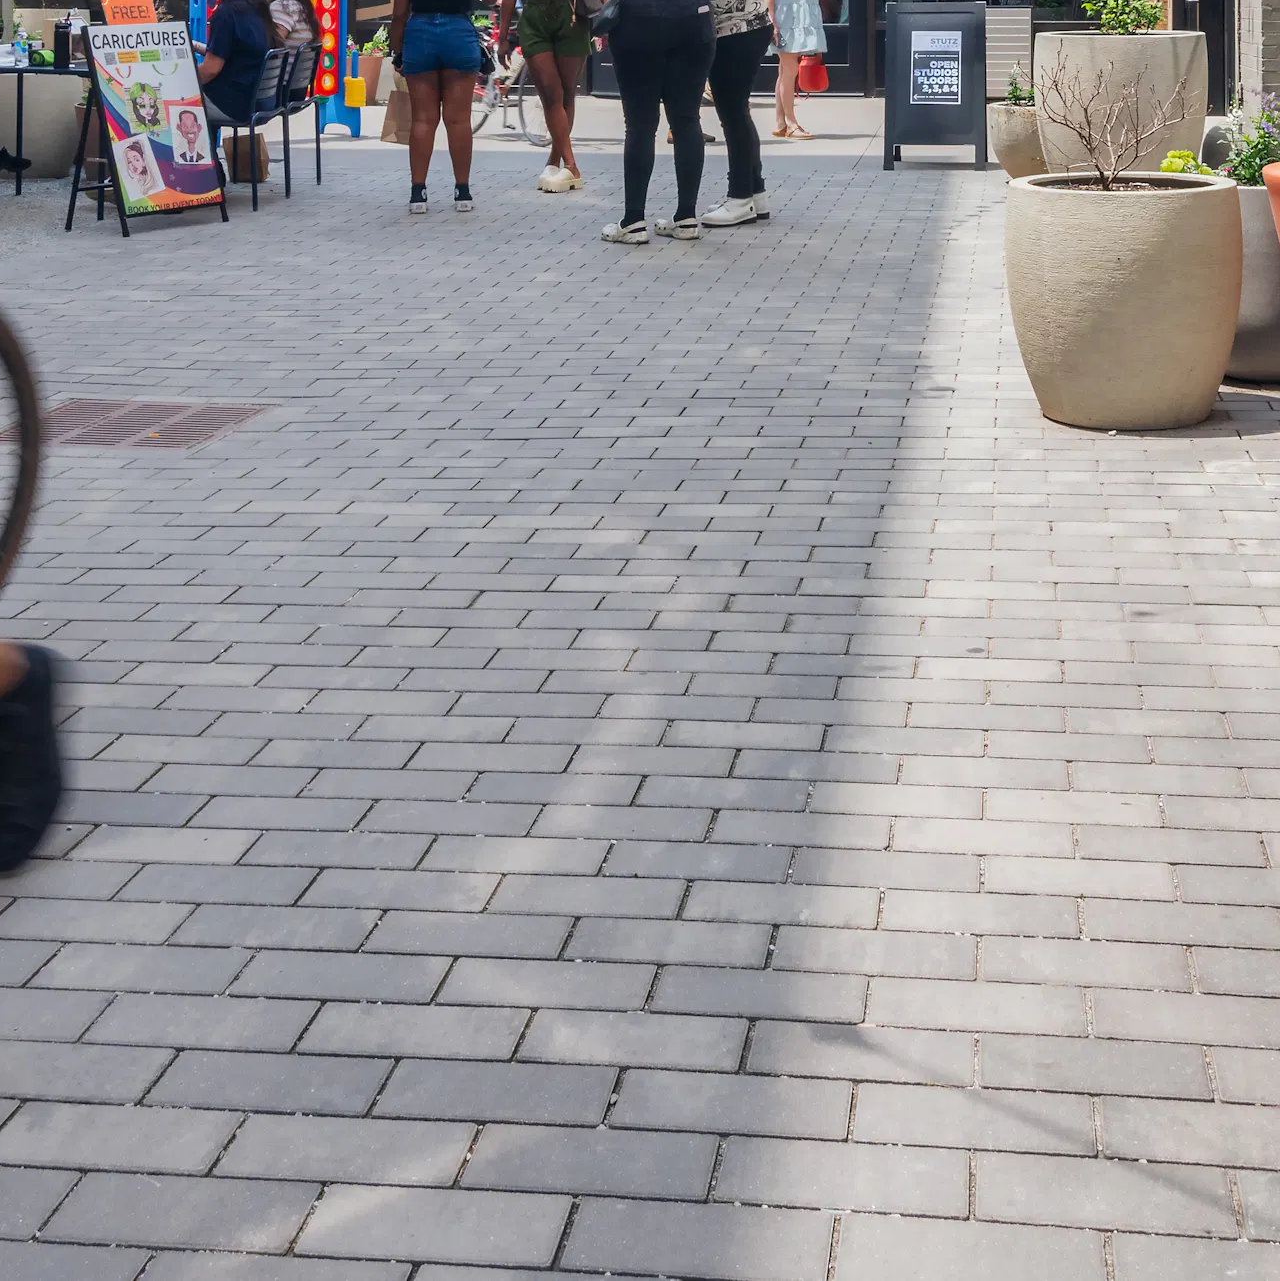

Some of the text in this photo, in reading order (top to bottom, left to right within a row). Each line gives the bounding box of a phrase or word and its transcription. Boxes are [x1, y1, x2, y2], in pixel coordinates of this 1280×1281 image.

[110, 6, 151, 20] FREE!
[92, 31, 186, 49] CARICATURES
[128, 205, 149, 214] BOOK
[151, 203, 170, 211] YOUR
[172, 199, 194, 208] EVENT
